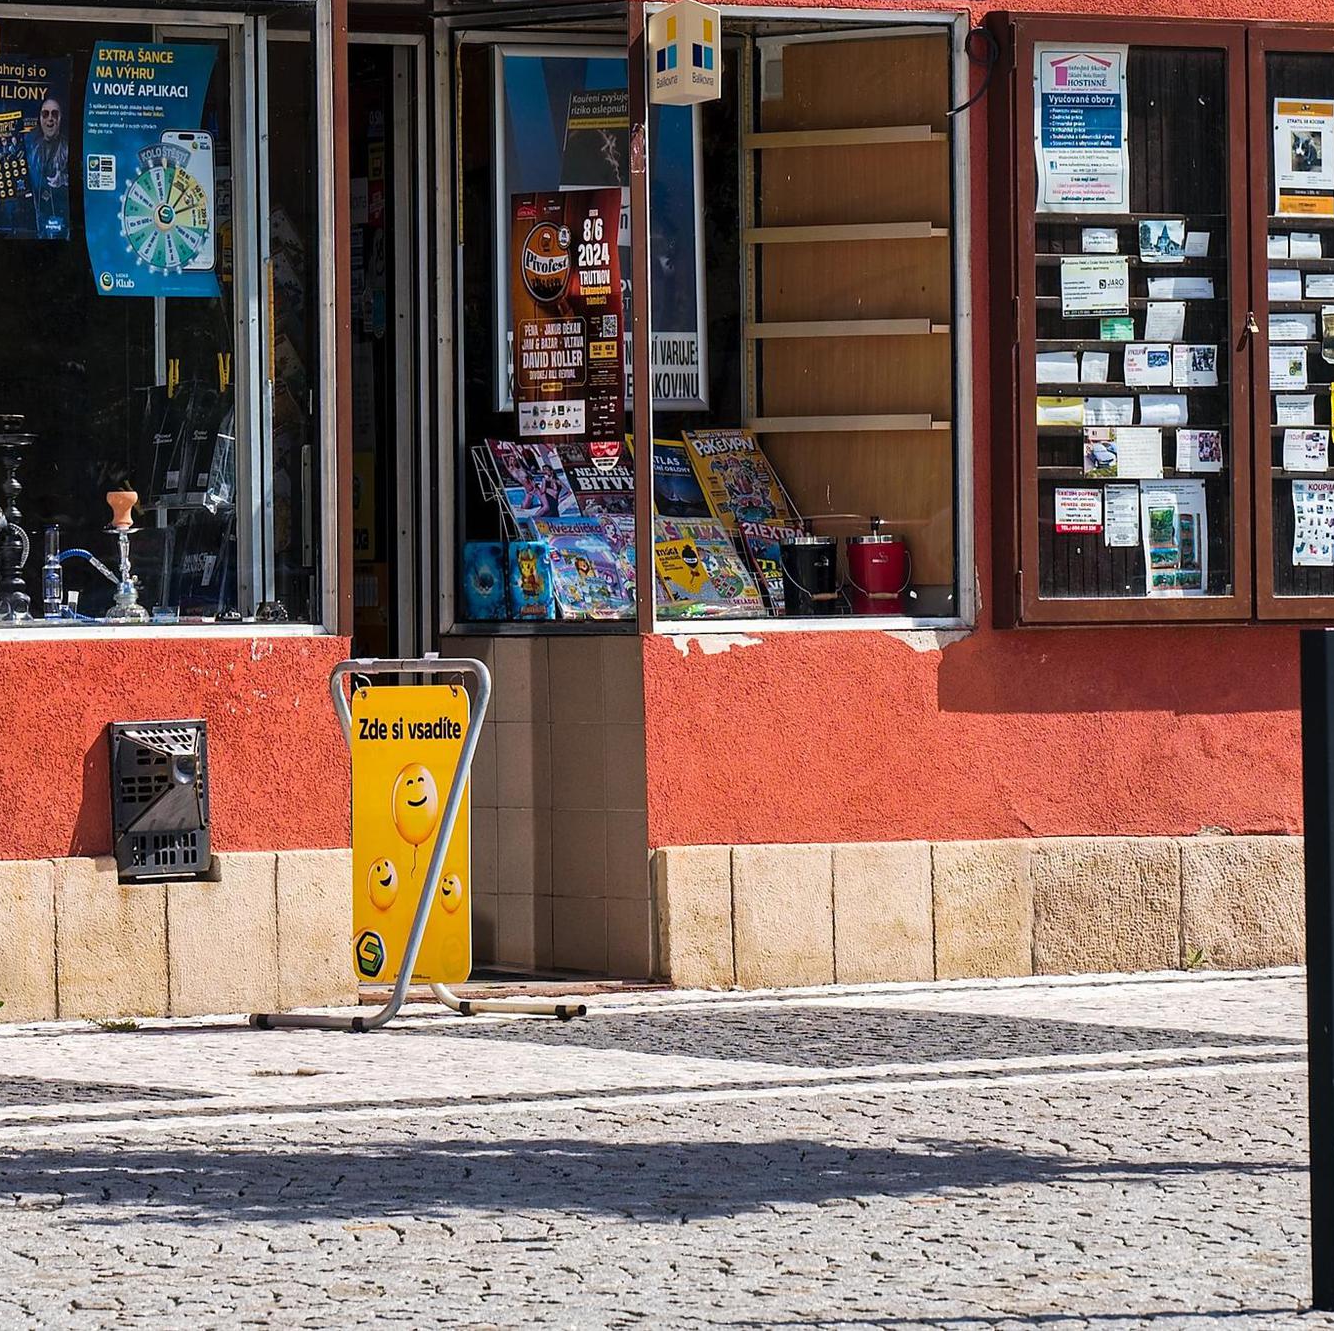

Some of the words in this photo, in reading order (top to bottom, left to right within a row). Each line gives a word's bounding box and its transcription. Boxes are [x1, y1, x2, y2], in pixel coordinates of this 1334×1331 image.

[99, 49, 135, 62] EXTRA
[138, 47, 174, 63] ŠANCE
[27, 64, 36, 77] si
[39, 68, 47, 77] o
[96, 66, 113, 78] NA
[116, 64, 155, 79] VÝHRU
[92, 83, 101, 95] V
[104, 81, 135, 96] NOVÉ
[138, 84, 189, 98] APLIKACI
[1067, 77, 1108, 87] HOSTINNÉ
[1048, 94, 1089, 105] Vyučované
[1091, 94, 1114, 105] obory
[583, 218, 604, 241] 8/6
[526, 251, 567, 273] Pivofest
[578, 242, 610, 267] 2024
[115, 278, 135, 288] Klub
[579, 269, 610, 286] TRUTNOV
[522, 351, 549, 369] DAVID
[551, 350, 583, 368] KOLLER
[358, 718, 387, 741] Zde
[392, 717, 403, 739] si
[407, 717, 462, 740] vsadíte
